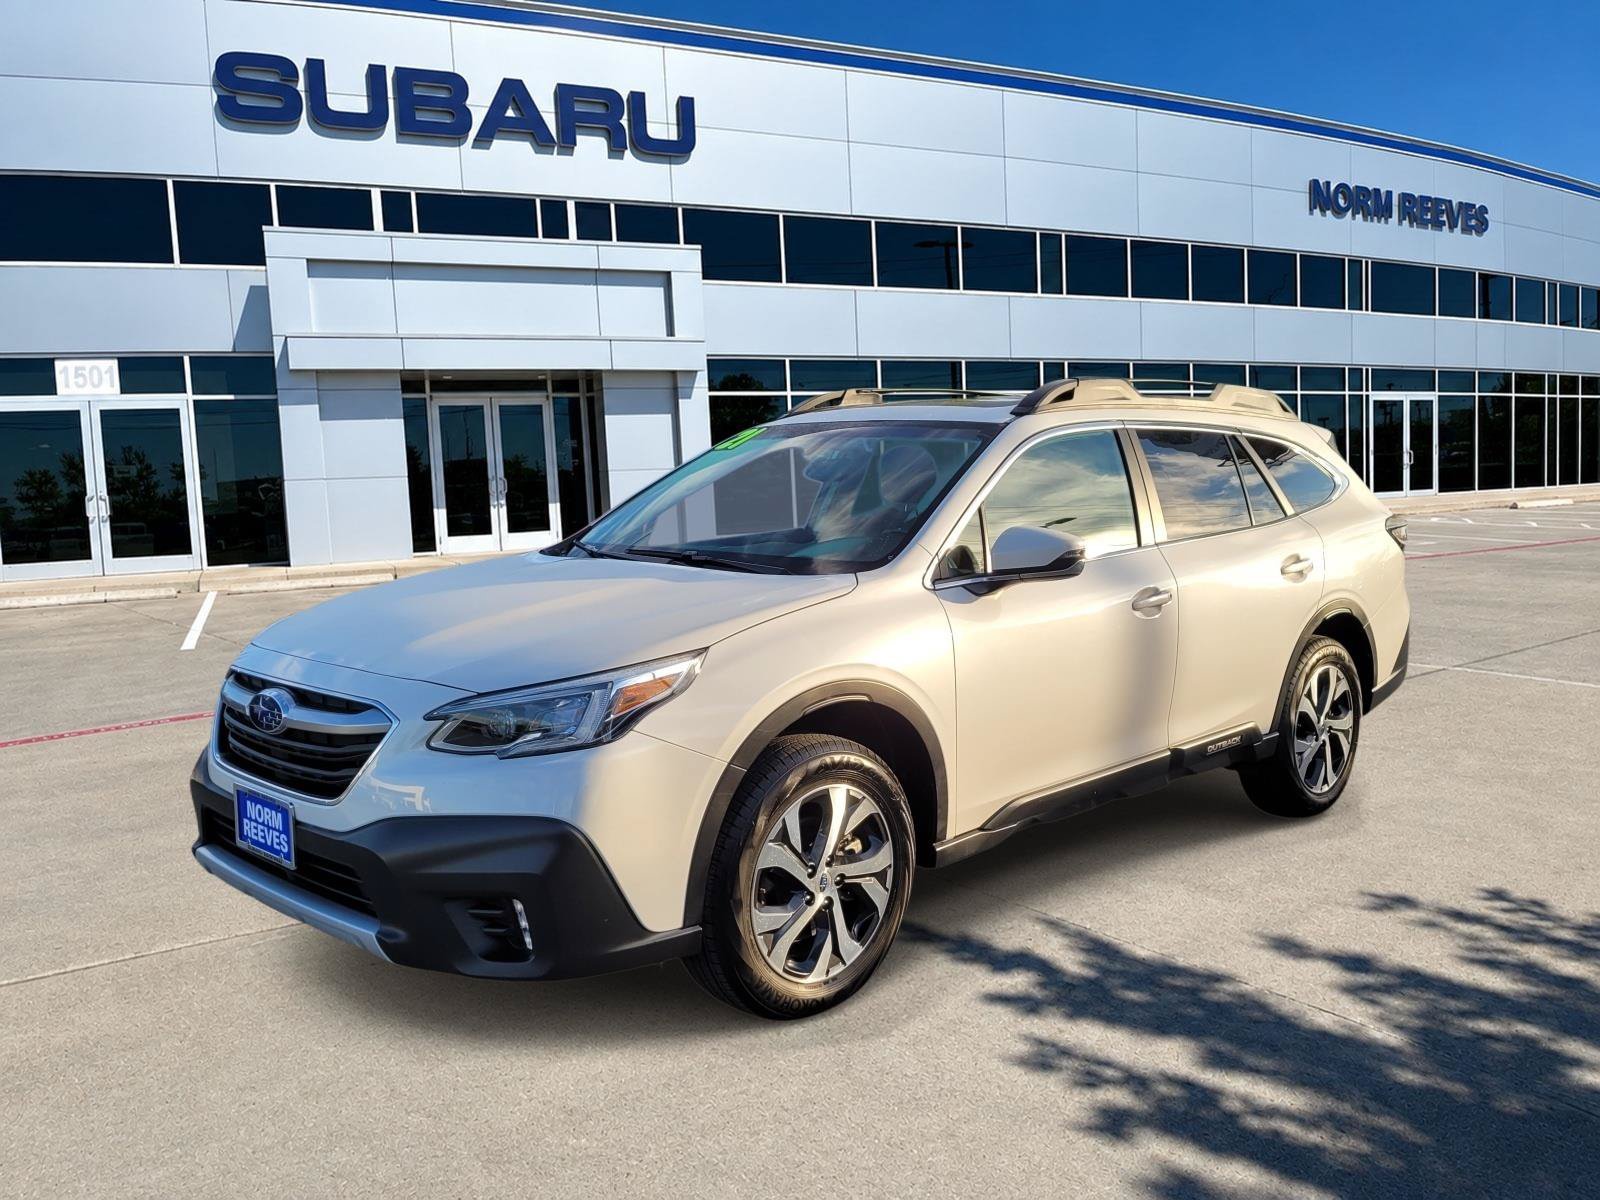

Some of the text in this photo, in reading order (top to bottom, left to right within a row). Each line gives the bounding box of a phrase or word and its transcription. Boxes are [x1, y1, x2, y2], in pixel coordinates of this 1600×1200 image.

[214, 51, 696, 156] SUBARU
[1309, 178, 1489, 236] NORM REEVES
[59, 364, 116, 389] 1501
[1207, 735, 1242, 753] OUTBACK
[246, 800, 283, 832] NORM
[243, 818, 289, 853] REEVES
